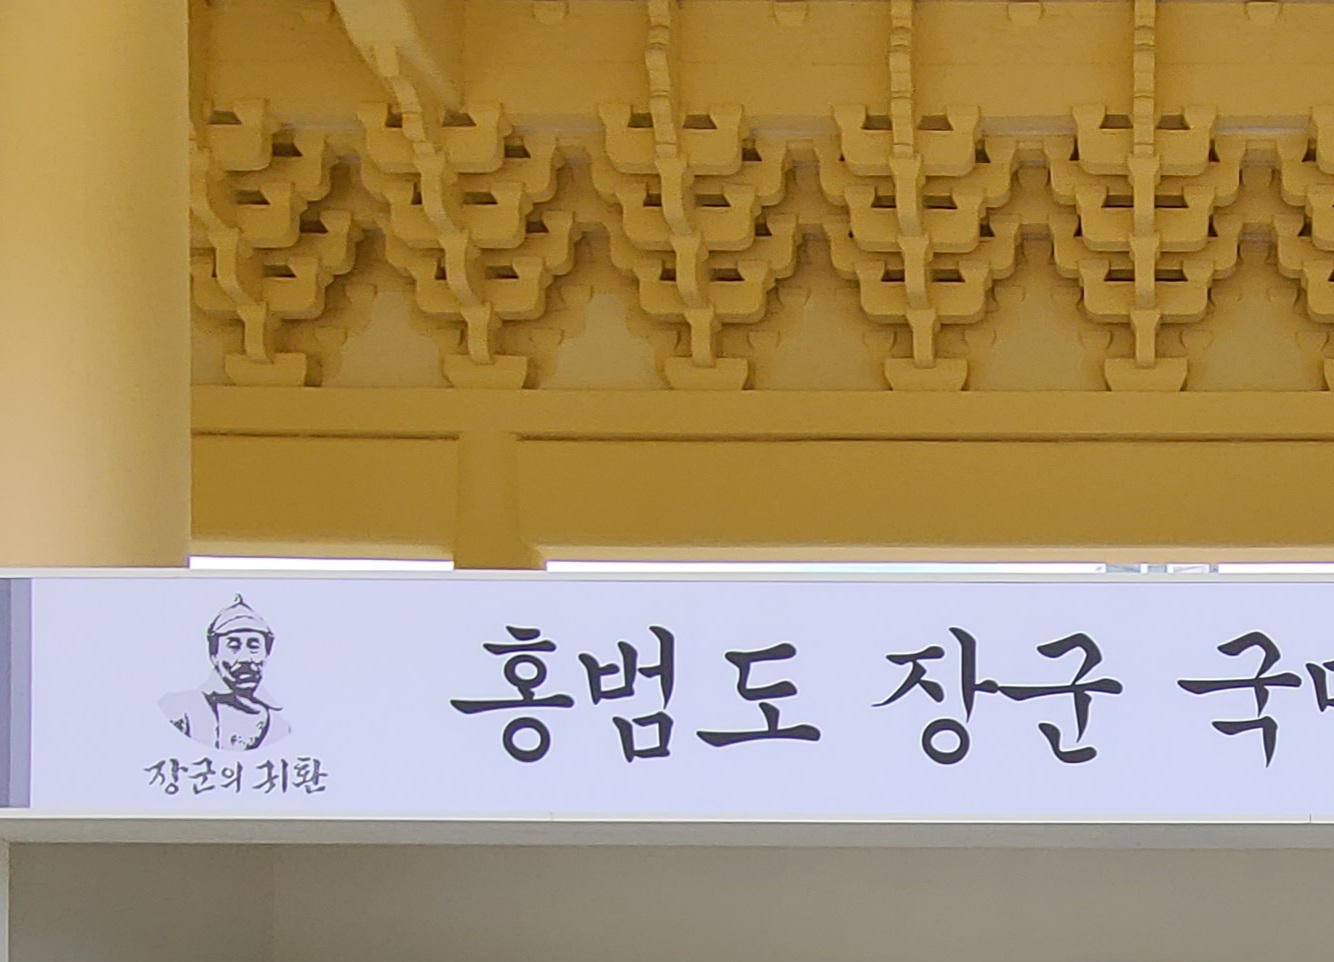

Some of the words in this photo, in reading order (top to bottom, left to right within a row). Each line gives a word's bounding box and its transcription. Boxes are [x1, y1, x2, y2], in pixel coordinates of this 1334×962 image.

[449, 624, 823, 765] 홍범도
[873, 627, 1125, 767] 장군
[143, 757, 245, 796] 장군의
[252, 757, 329, 795] 귀환
